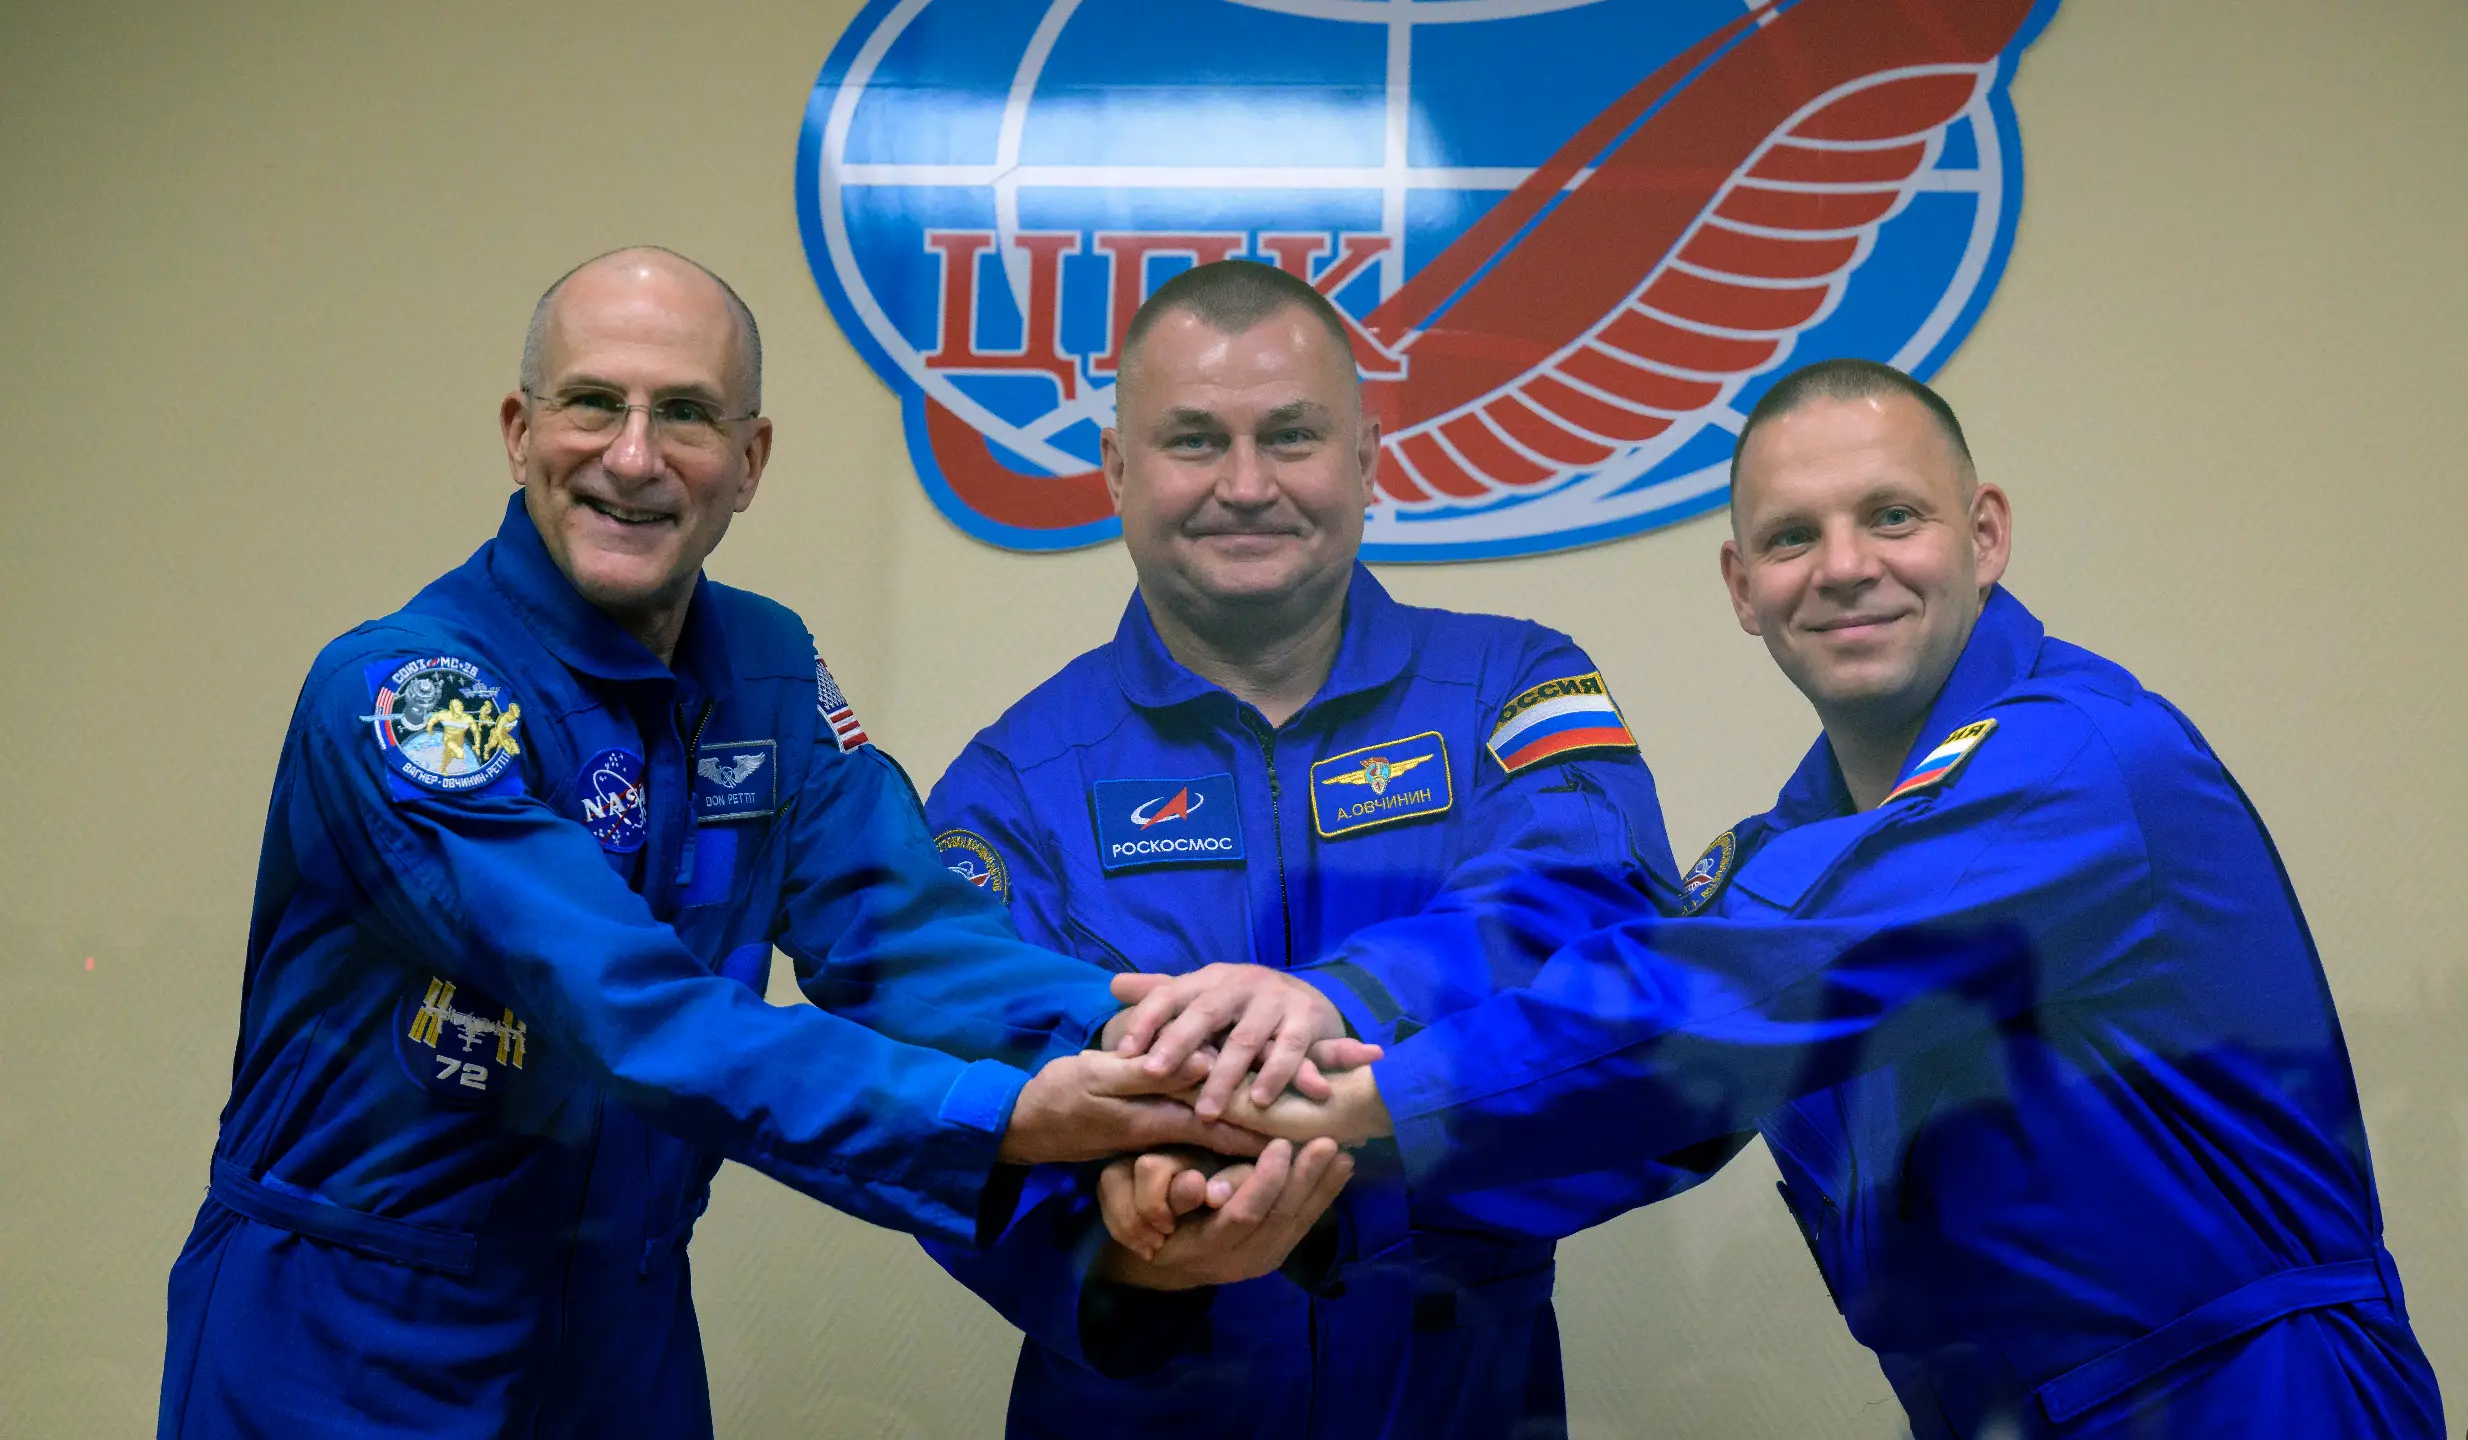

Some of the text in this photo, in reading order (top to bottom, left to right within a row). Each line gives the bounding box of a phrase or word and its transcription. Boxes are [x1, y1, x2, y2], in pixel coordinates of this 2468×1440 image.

[391, 658, 427, 685] СОЮЗ
[1499, 676, 1603, 723] ОССИЯ
[705, 792, 756, 807] DON PETTIT
[1337, 788, 1431, 822] А.ОВЧИНИН
[1112, 837, 1233, 858] РОСКОСМОС
[436, 1054, 489, 1091] 72
